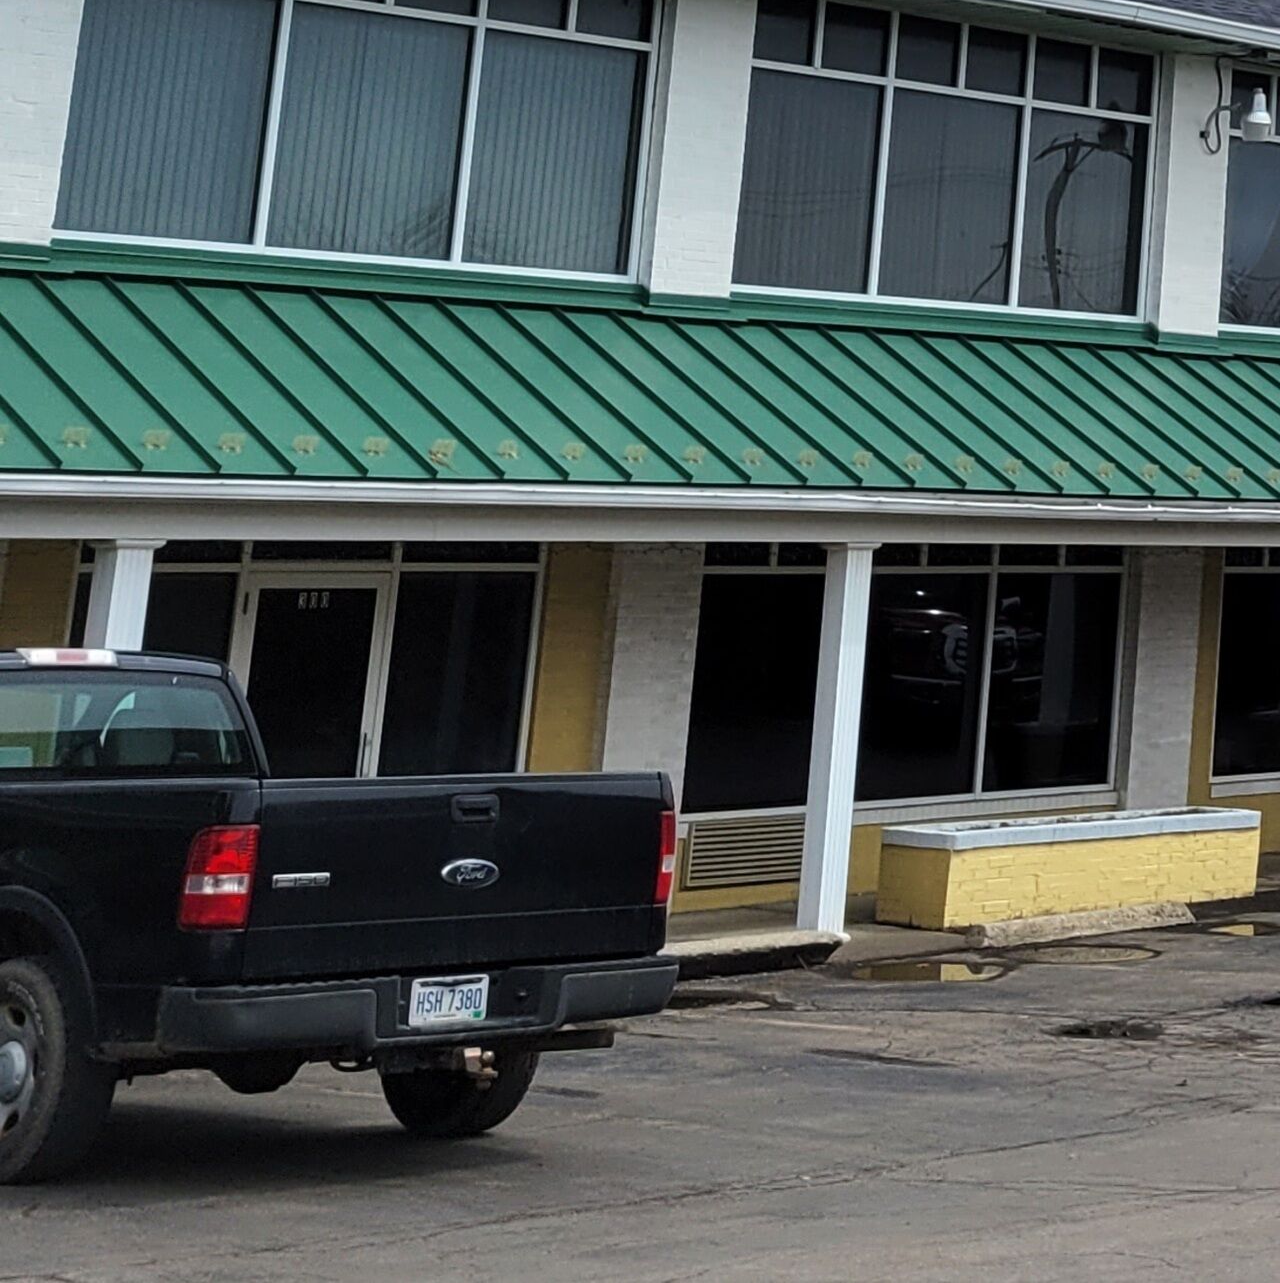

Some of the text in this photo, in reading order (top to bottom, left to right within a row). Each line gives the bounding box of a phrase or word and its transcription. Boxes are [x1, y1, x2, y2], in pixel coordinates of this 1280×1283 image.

[456, 865, 488, 884] Ford
[416, 987, 483, 1015] HSH 7380
